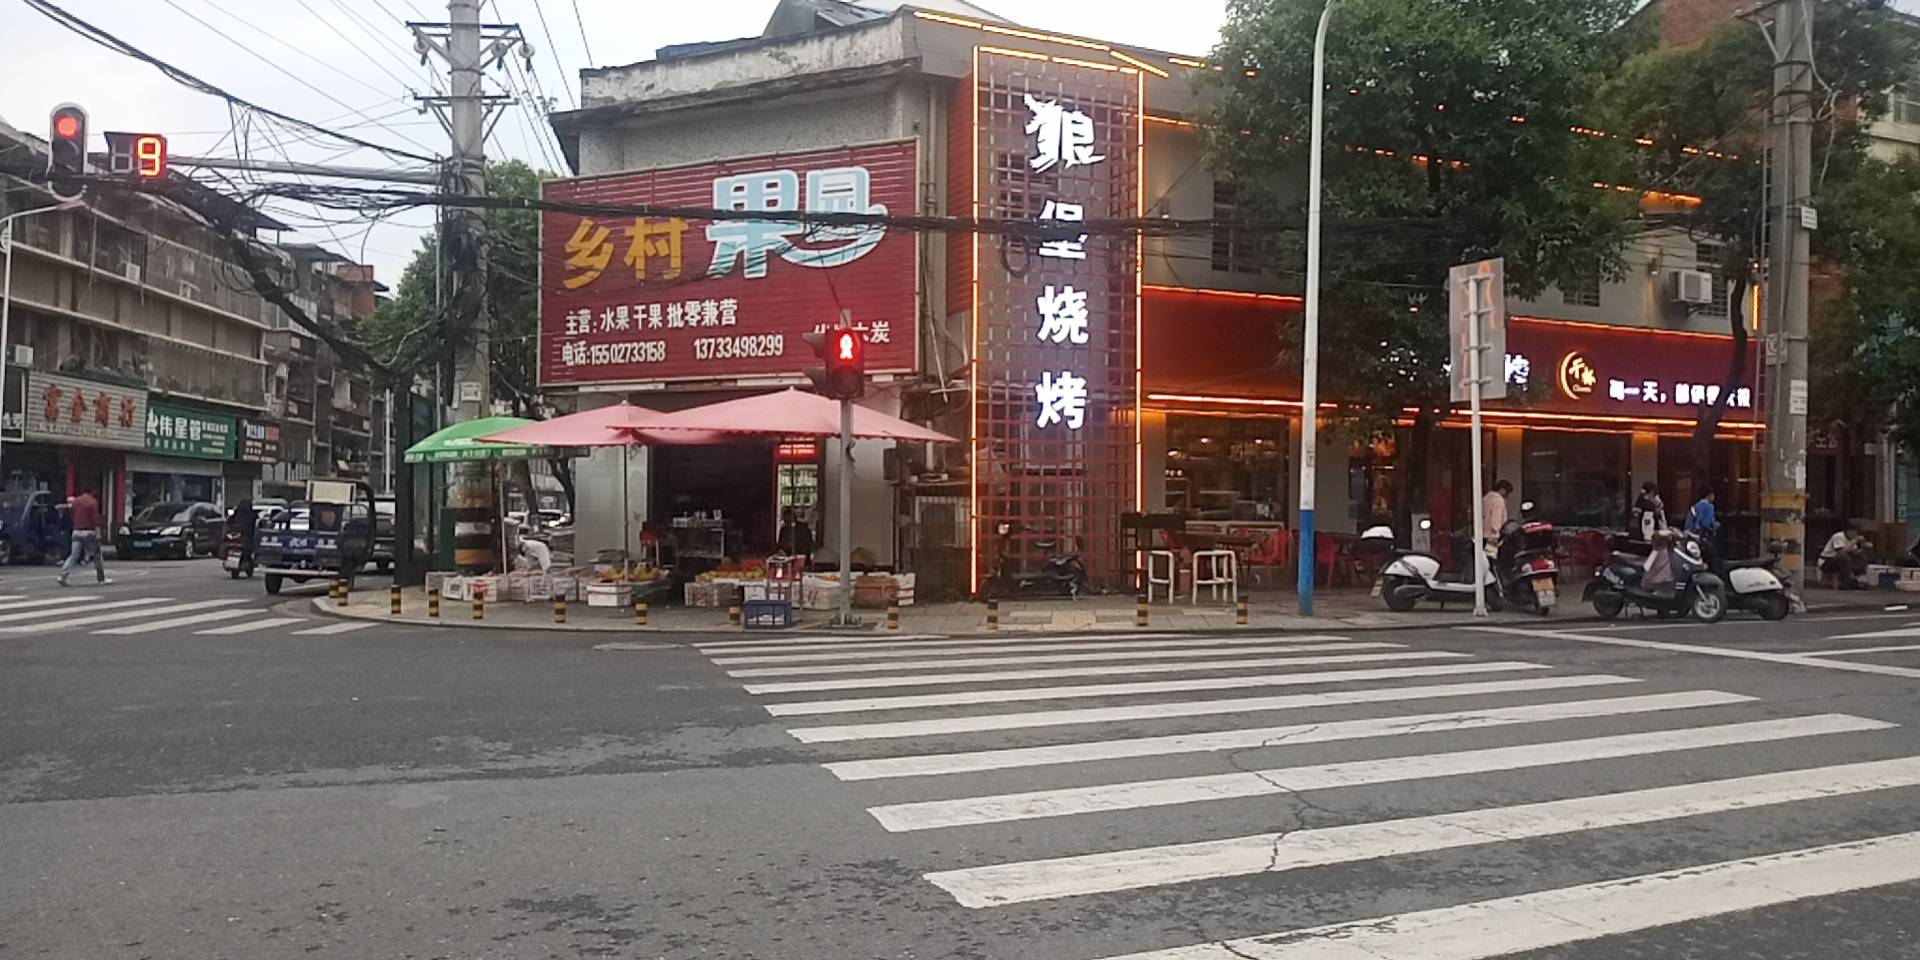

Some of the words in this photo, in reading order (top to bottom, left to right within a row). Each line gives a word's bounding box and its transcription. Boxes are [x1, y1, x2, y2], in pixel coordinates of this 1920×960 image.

[137, 136, 162, 177] 9
[562, 216, 690, 290] 乡村
[693, 334, 784, 360] 13733498299
